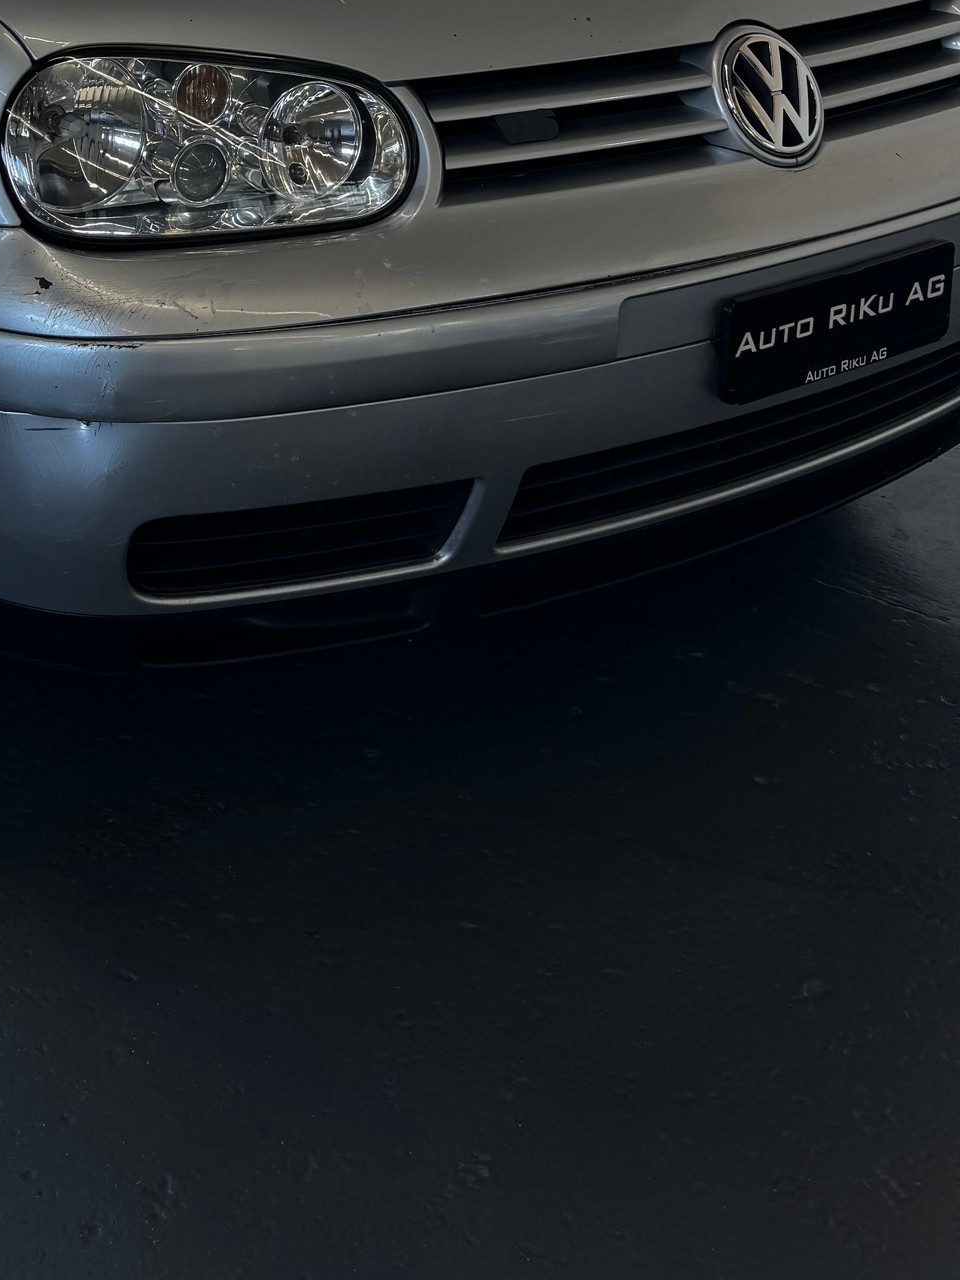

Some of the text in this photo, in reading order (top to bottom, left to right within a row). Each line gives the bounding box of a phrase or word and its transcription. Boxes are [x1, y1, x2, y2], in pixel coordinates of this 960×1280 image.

[732, 32, 821, 154] VW
[734, 316, 815, 358] AUTO
[905, 274, 946, 307] AG
[805, 364, 837, 384] AUTO
[870, 346, 888, 362] AG
